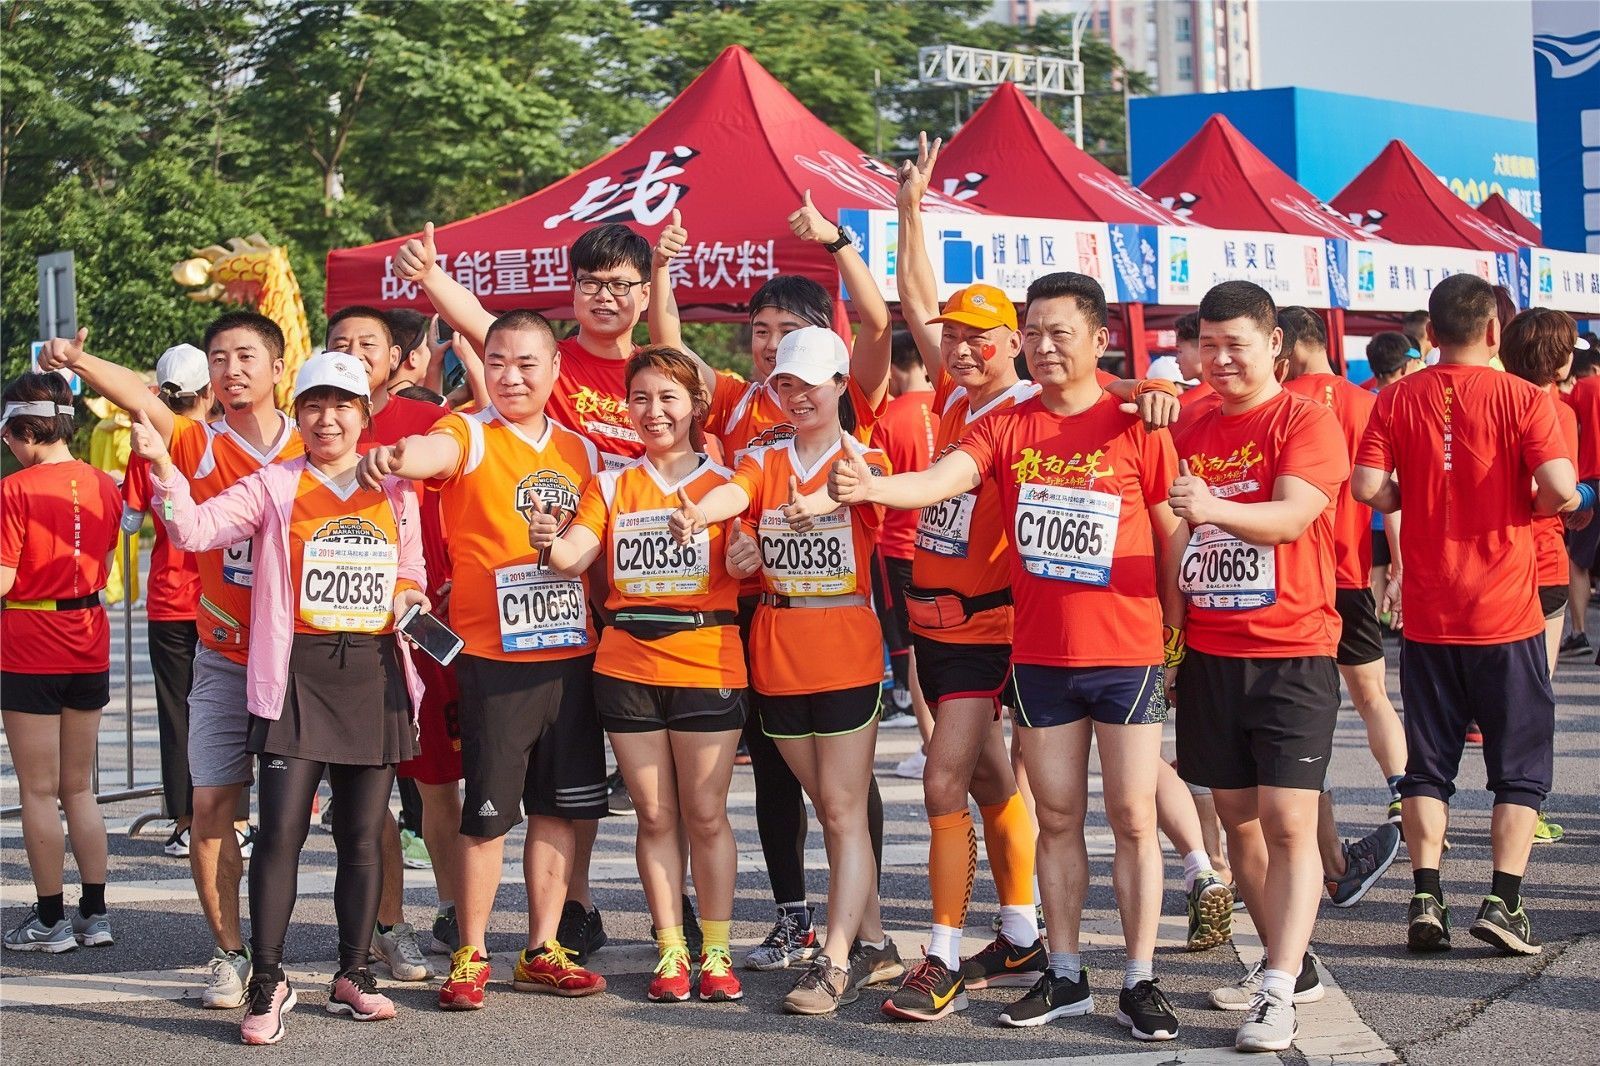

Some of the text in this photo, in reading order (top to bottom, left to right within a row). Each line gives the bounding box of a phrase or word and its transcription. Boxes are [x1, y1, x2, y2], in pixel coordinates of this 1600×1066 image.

[992, 233, 1056, 265] 媒体区
[534, 482, 566, 490] MARATHON
[1018, 512, 1104, 556] C10665
[617, 536, 697, 571] C20336
[762, 536, 841, 569] C20338
[1183, 548, 1259, 583] C10663
[305, 568, 385, 604] C20335
[502, 590, 580, 625] C10659
